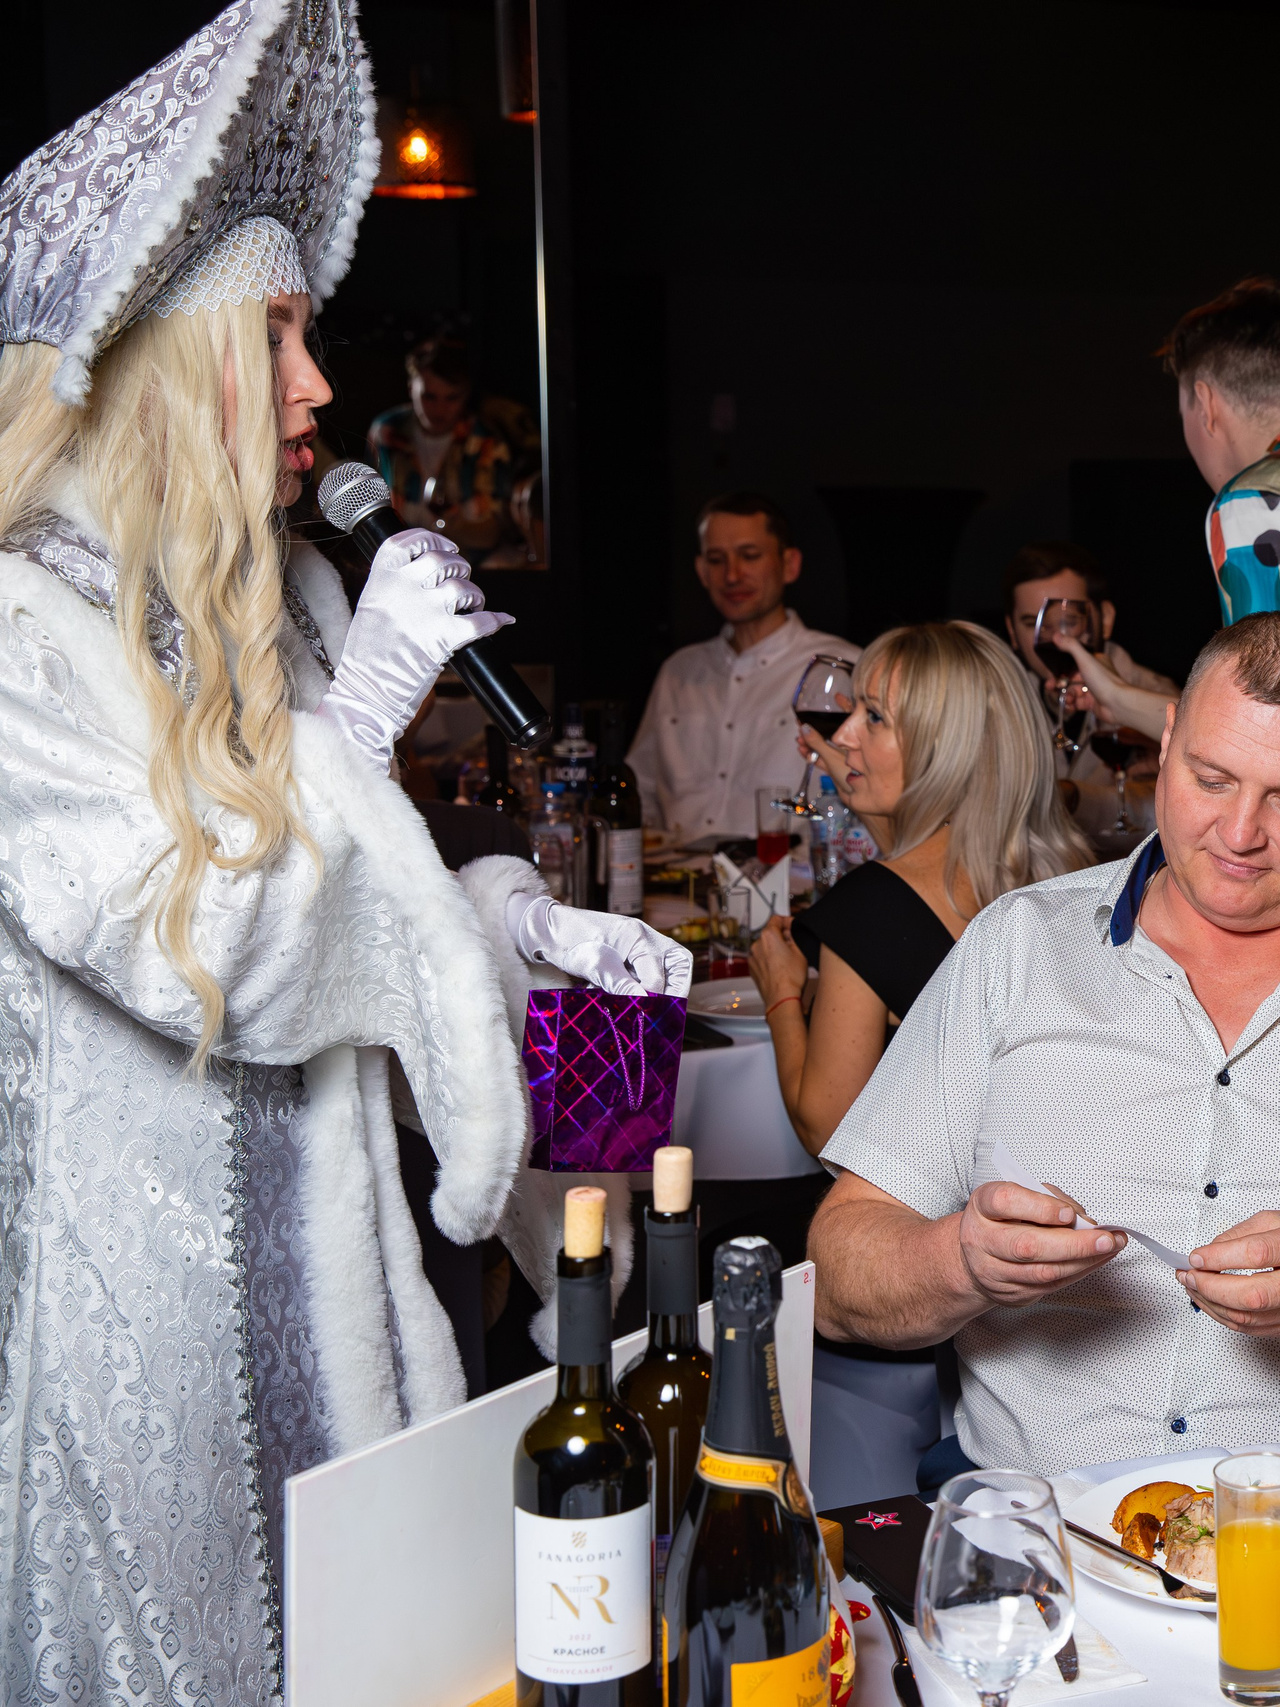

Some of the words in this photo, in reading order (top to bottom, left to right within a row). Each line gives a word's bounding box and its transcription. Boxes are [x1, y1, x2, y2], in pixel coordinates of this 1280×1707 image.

[538, 1549, 622, 1563] FANAGORIA
[546, 1574, 619, 1625] NR
[553, 1646, 606, 1656] КРАСНОЕ
